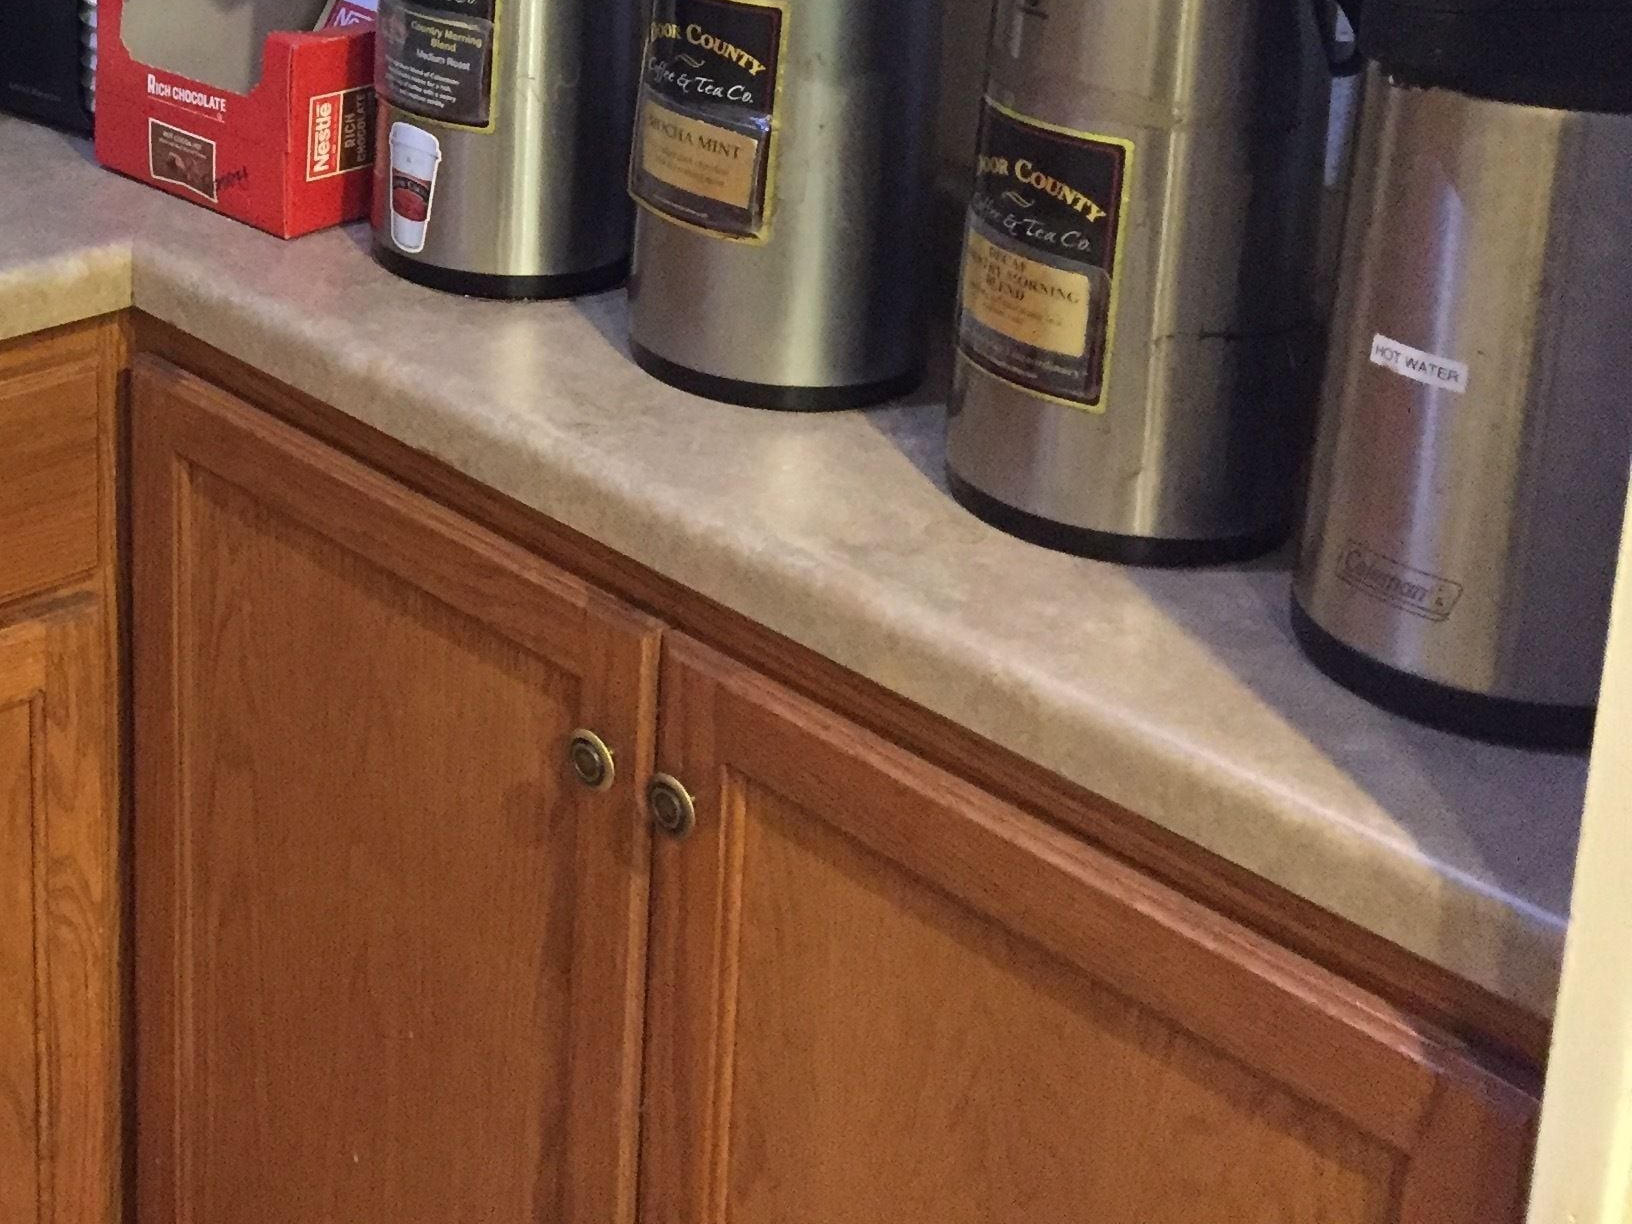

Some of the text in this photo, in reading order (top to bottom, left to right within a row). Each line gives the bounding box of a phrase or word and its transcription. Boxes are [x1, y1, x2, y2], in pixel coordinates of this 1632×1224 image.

[410, 19, 483, 49] Country Morning
[430, 37, 457, 53] Blend
[686, 24, 767, 76] COUNTY
[416, 47, 446, 65] Medium
[447, 57, 471, 71] Roast
[147, 73, 227, 113] RICH CHOCOLATE
[676, 74, 692, 93] &
[695, 77, 724, 97] Tea
[727, 85, 754, 104] Co.
[344, 112, 357, 149] RICH
[356, 92, 367, 163] CHOCOLATE
[698, 135, 742, 160] MINT
[1014, 159, 1107, 223] COUNTY
[1003, 214, 1021, 236] &
[1024, 218, 1057, 243] Tea
[1060, 231, 1091, 253] Co.
[1374, 345, 1460, 383] HOT WATER
